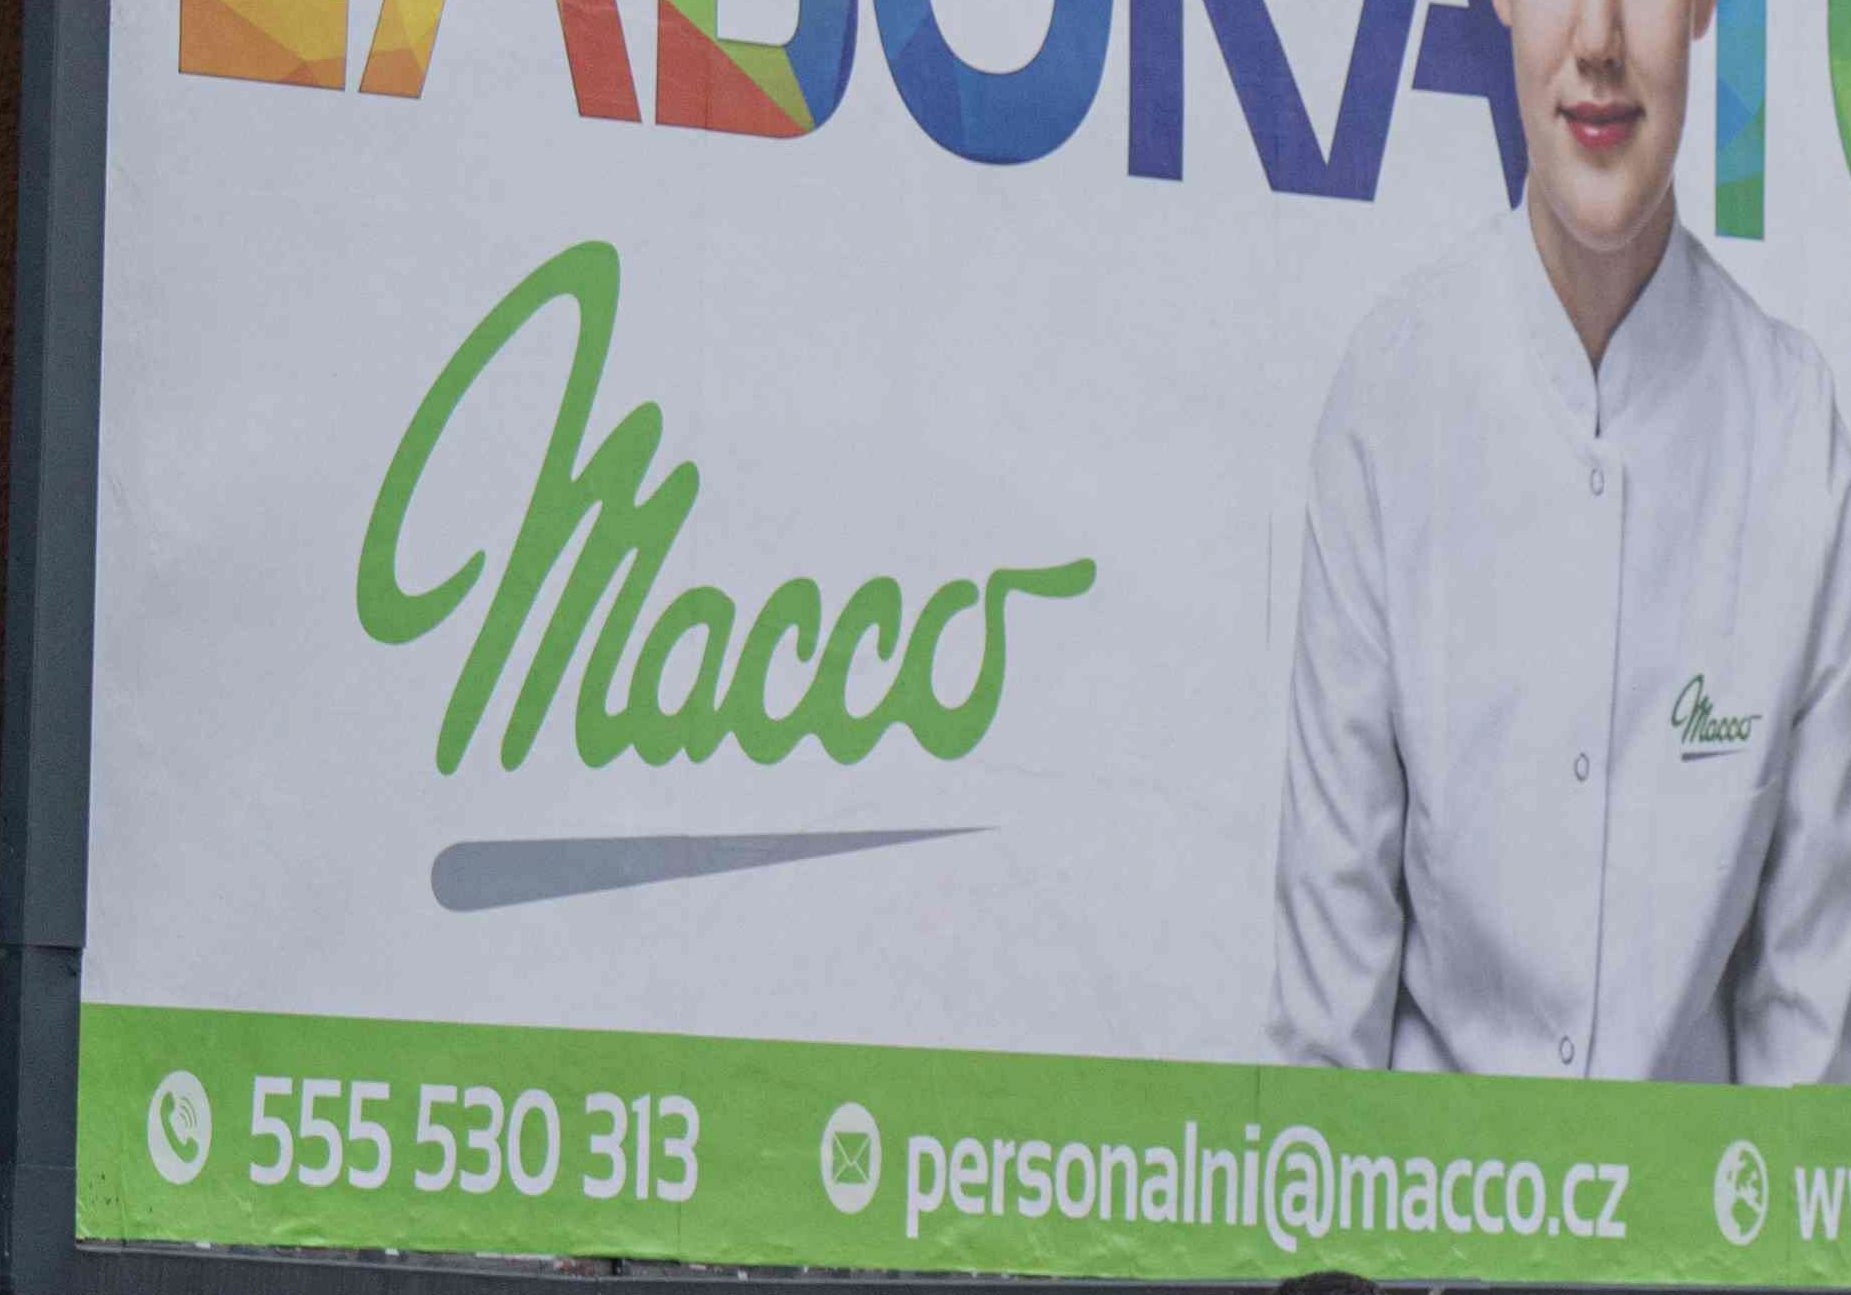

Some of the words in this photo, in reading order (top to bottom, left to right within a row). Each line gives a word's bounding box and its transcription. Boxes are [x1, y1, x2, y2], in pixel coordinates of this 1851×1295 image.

[356, 240, 1097, 776] Macco
[1671, 673, 1763, 744] Macco
[250, 1076, 392, 1190] 555
[413, 1084, 561, 1196] 530
[582, 1091, 701, 1201] 313
[905, 1120, 1632, 1253] personalni@macco.cz
